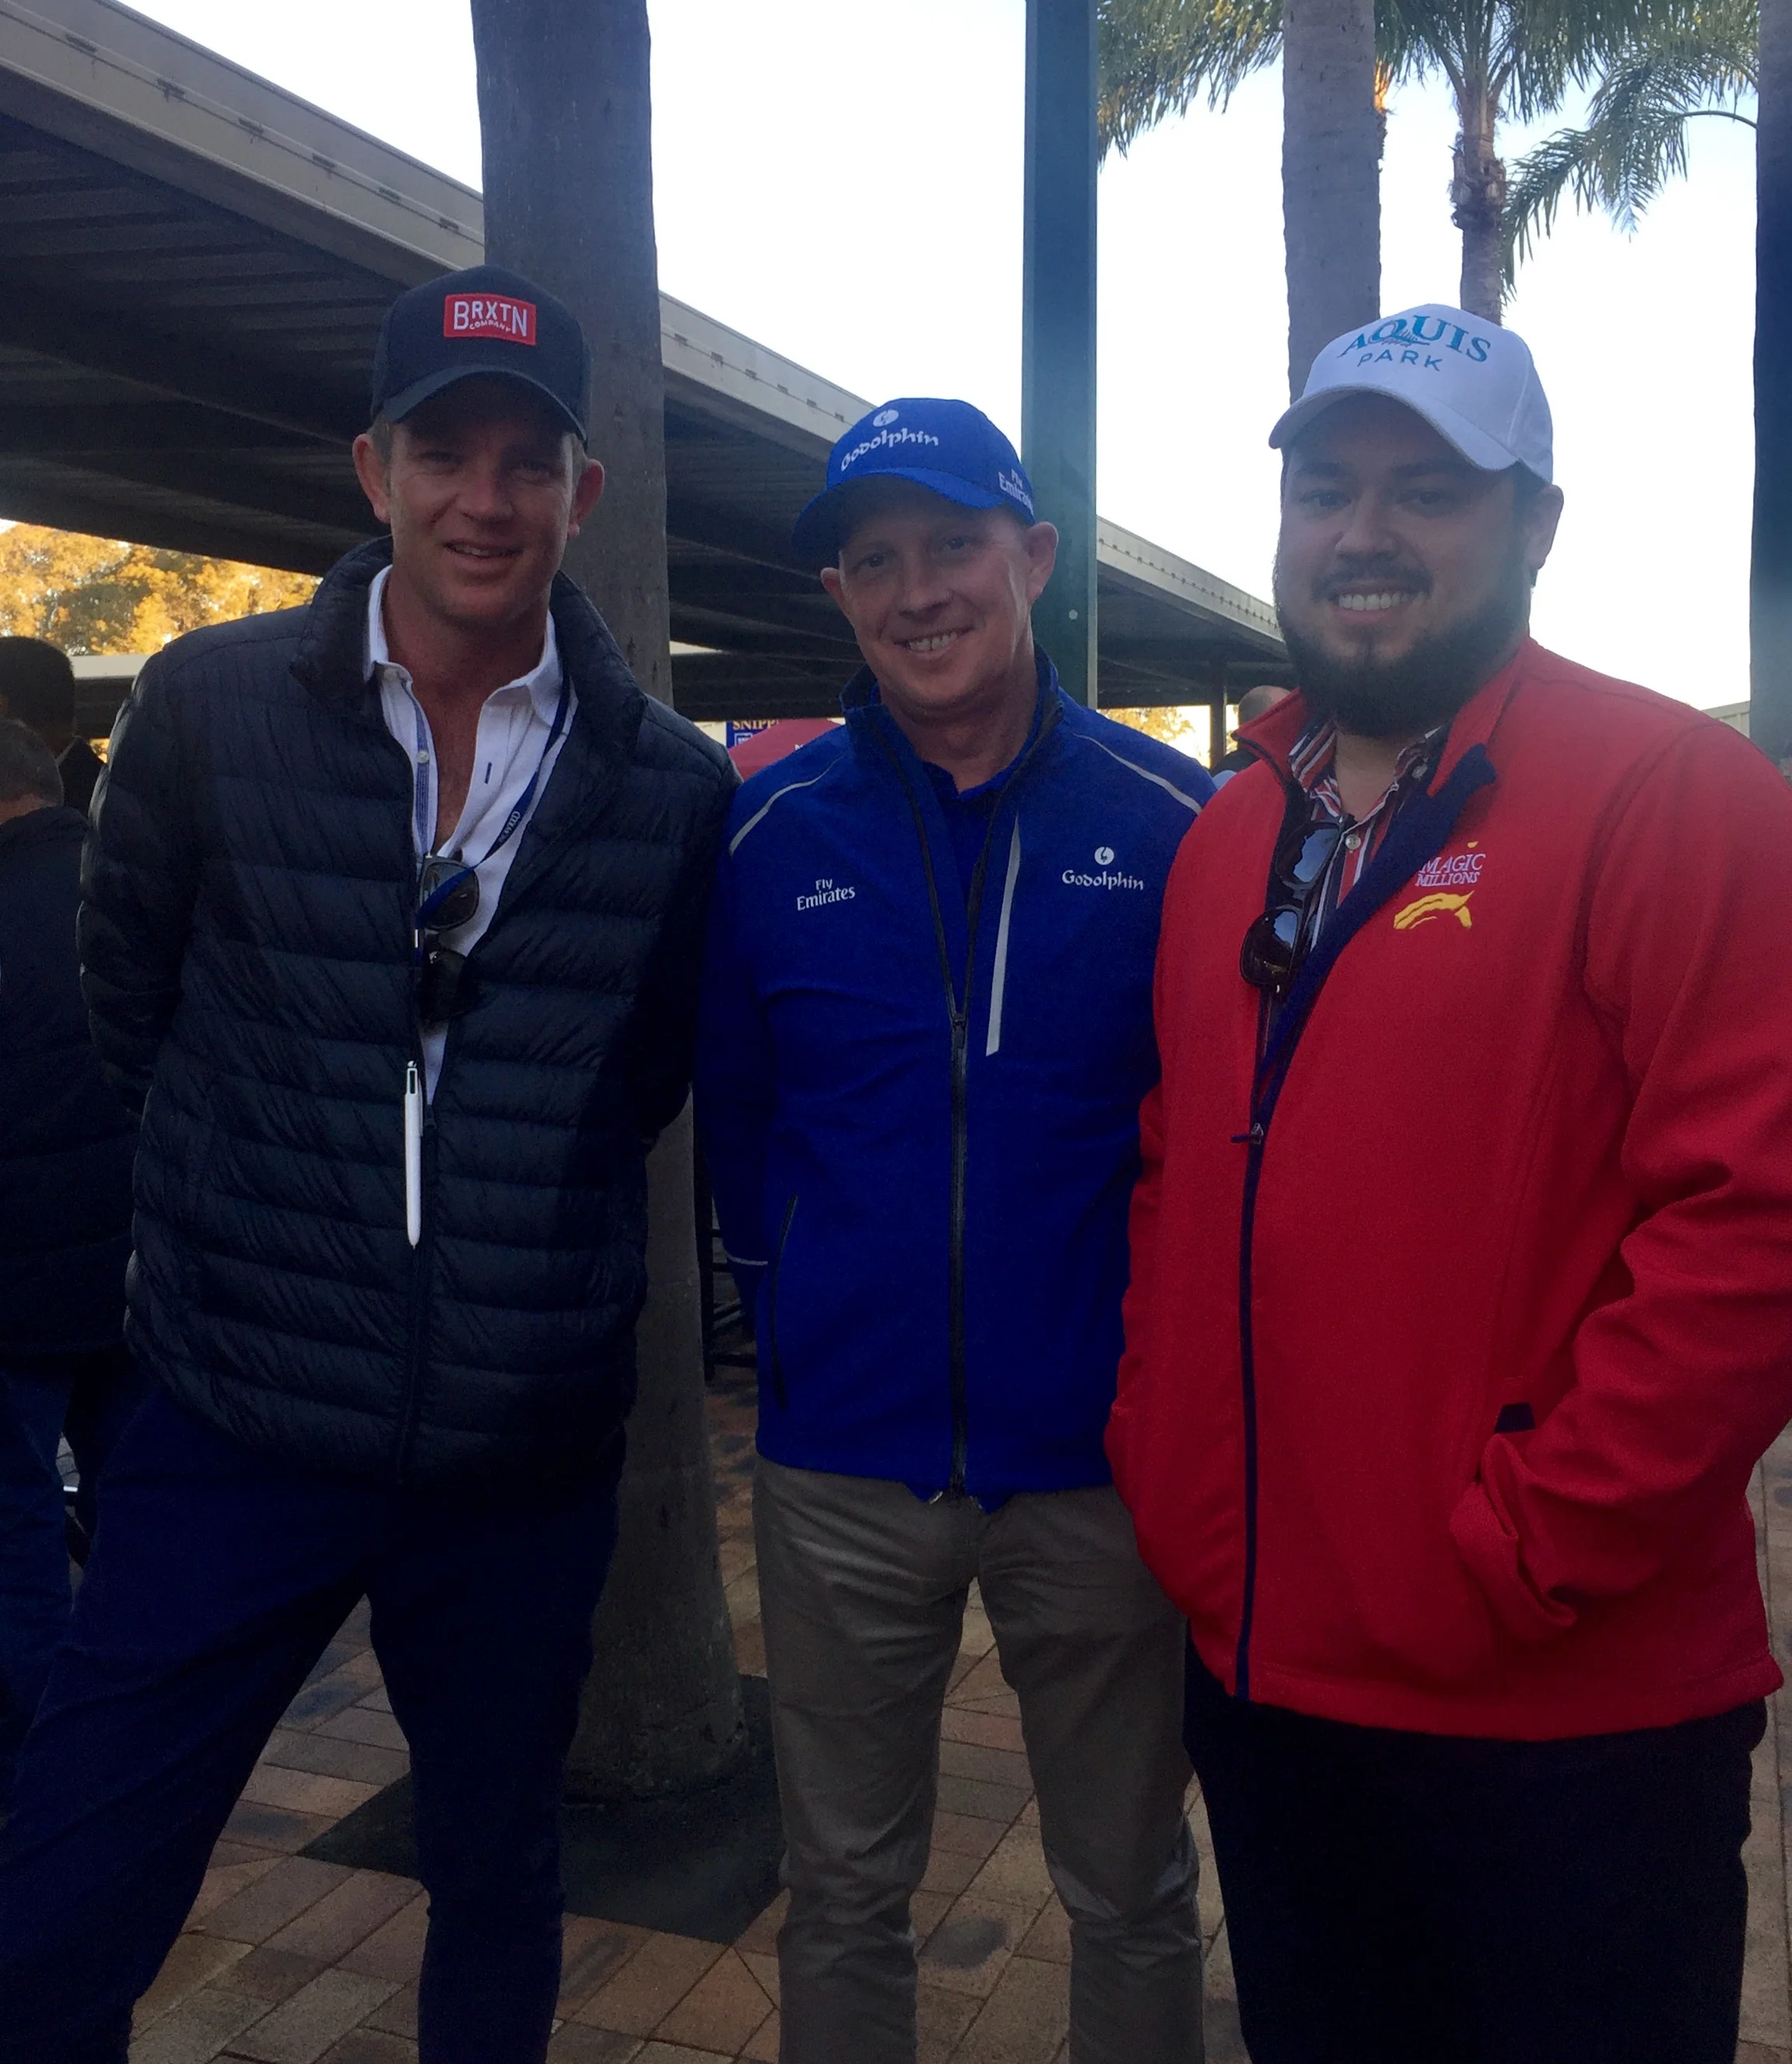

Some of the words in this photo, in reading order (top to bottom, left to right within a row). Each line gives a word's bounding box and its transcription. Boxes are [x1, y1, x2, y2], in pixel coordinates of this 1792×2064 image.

[454, 300, 528, 337] BRXTN
[468, 319, 512, 333] COMPANY
[1337, 314, 1492, 363] AQUIS
[1357, 349, 1443, 372] PARK
[840, 427, 939, 472] Godolphin
[733, 719, 779, 731] SNIPP
[1418, 853, 1486, 874] MAGIC
[815, 878, 833, 891] Fly
[1062, 869, 1144, 891] Godolphin
[1415, 871, 1480, 887] MILLIONS
[796, 886, 856, 911] Emirates
